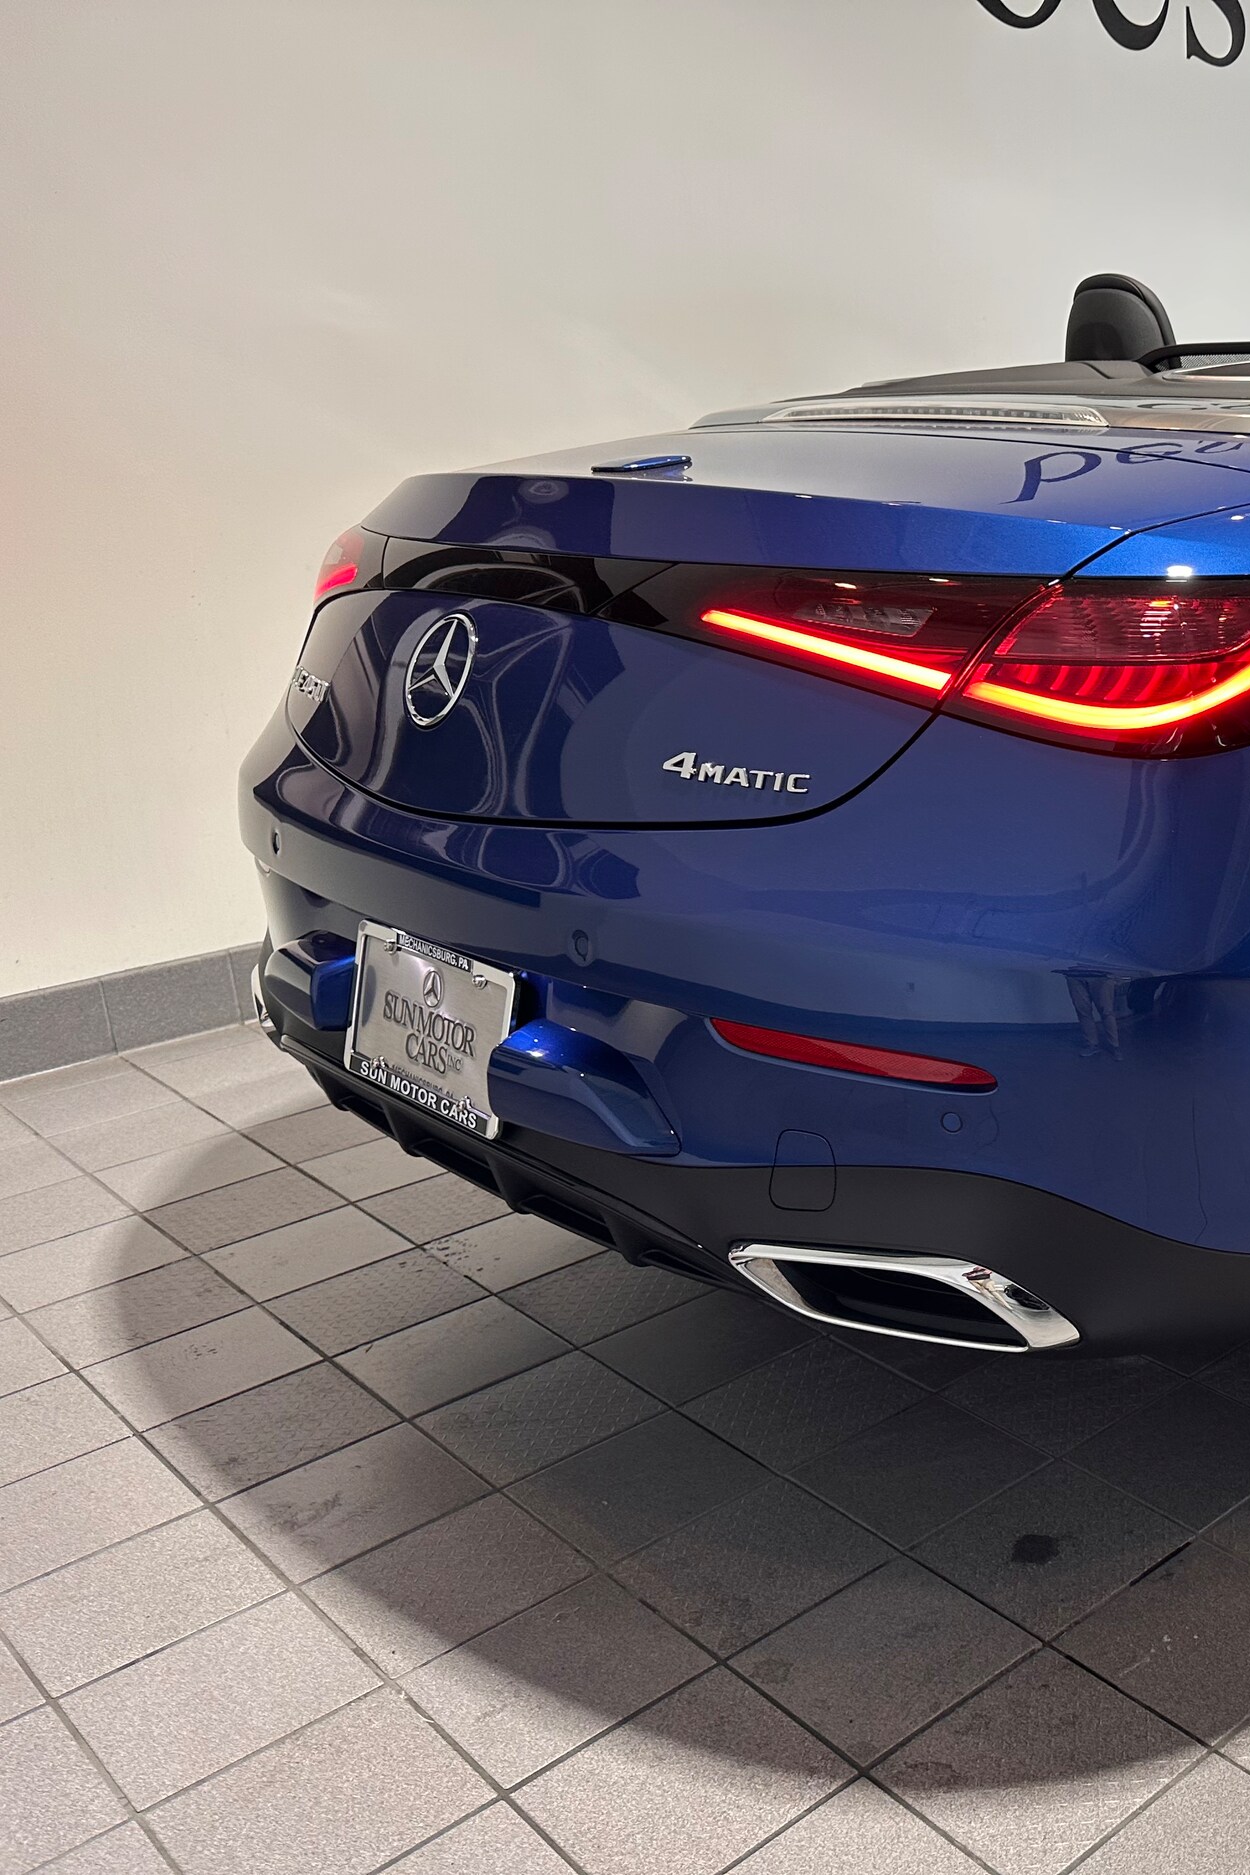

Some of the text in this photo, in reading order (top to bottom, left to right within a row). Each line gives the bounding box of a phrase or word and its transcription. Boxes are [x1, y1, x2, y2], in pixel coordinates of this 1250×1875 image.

[662, 751, 811, 793] 4MATIC
[383, 990, 475, 1057] SUN MOTOR
[405, 1032, 448, 1075] CARS
[360, 1060, 477, 1129] SUN MOTOR CARS
